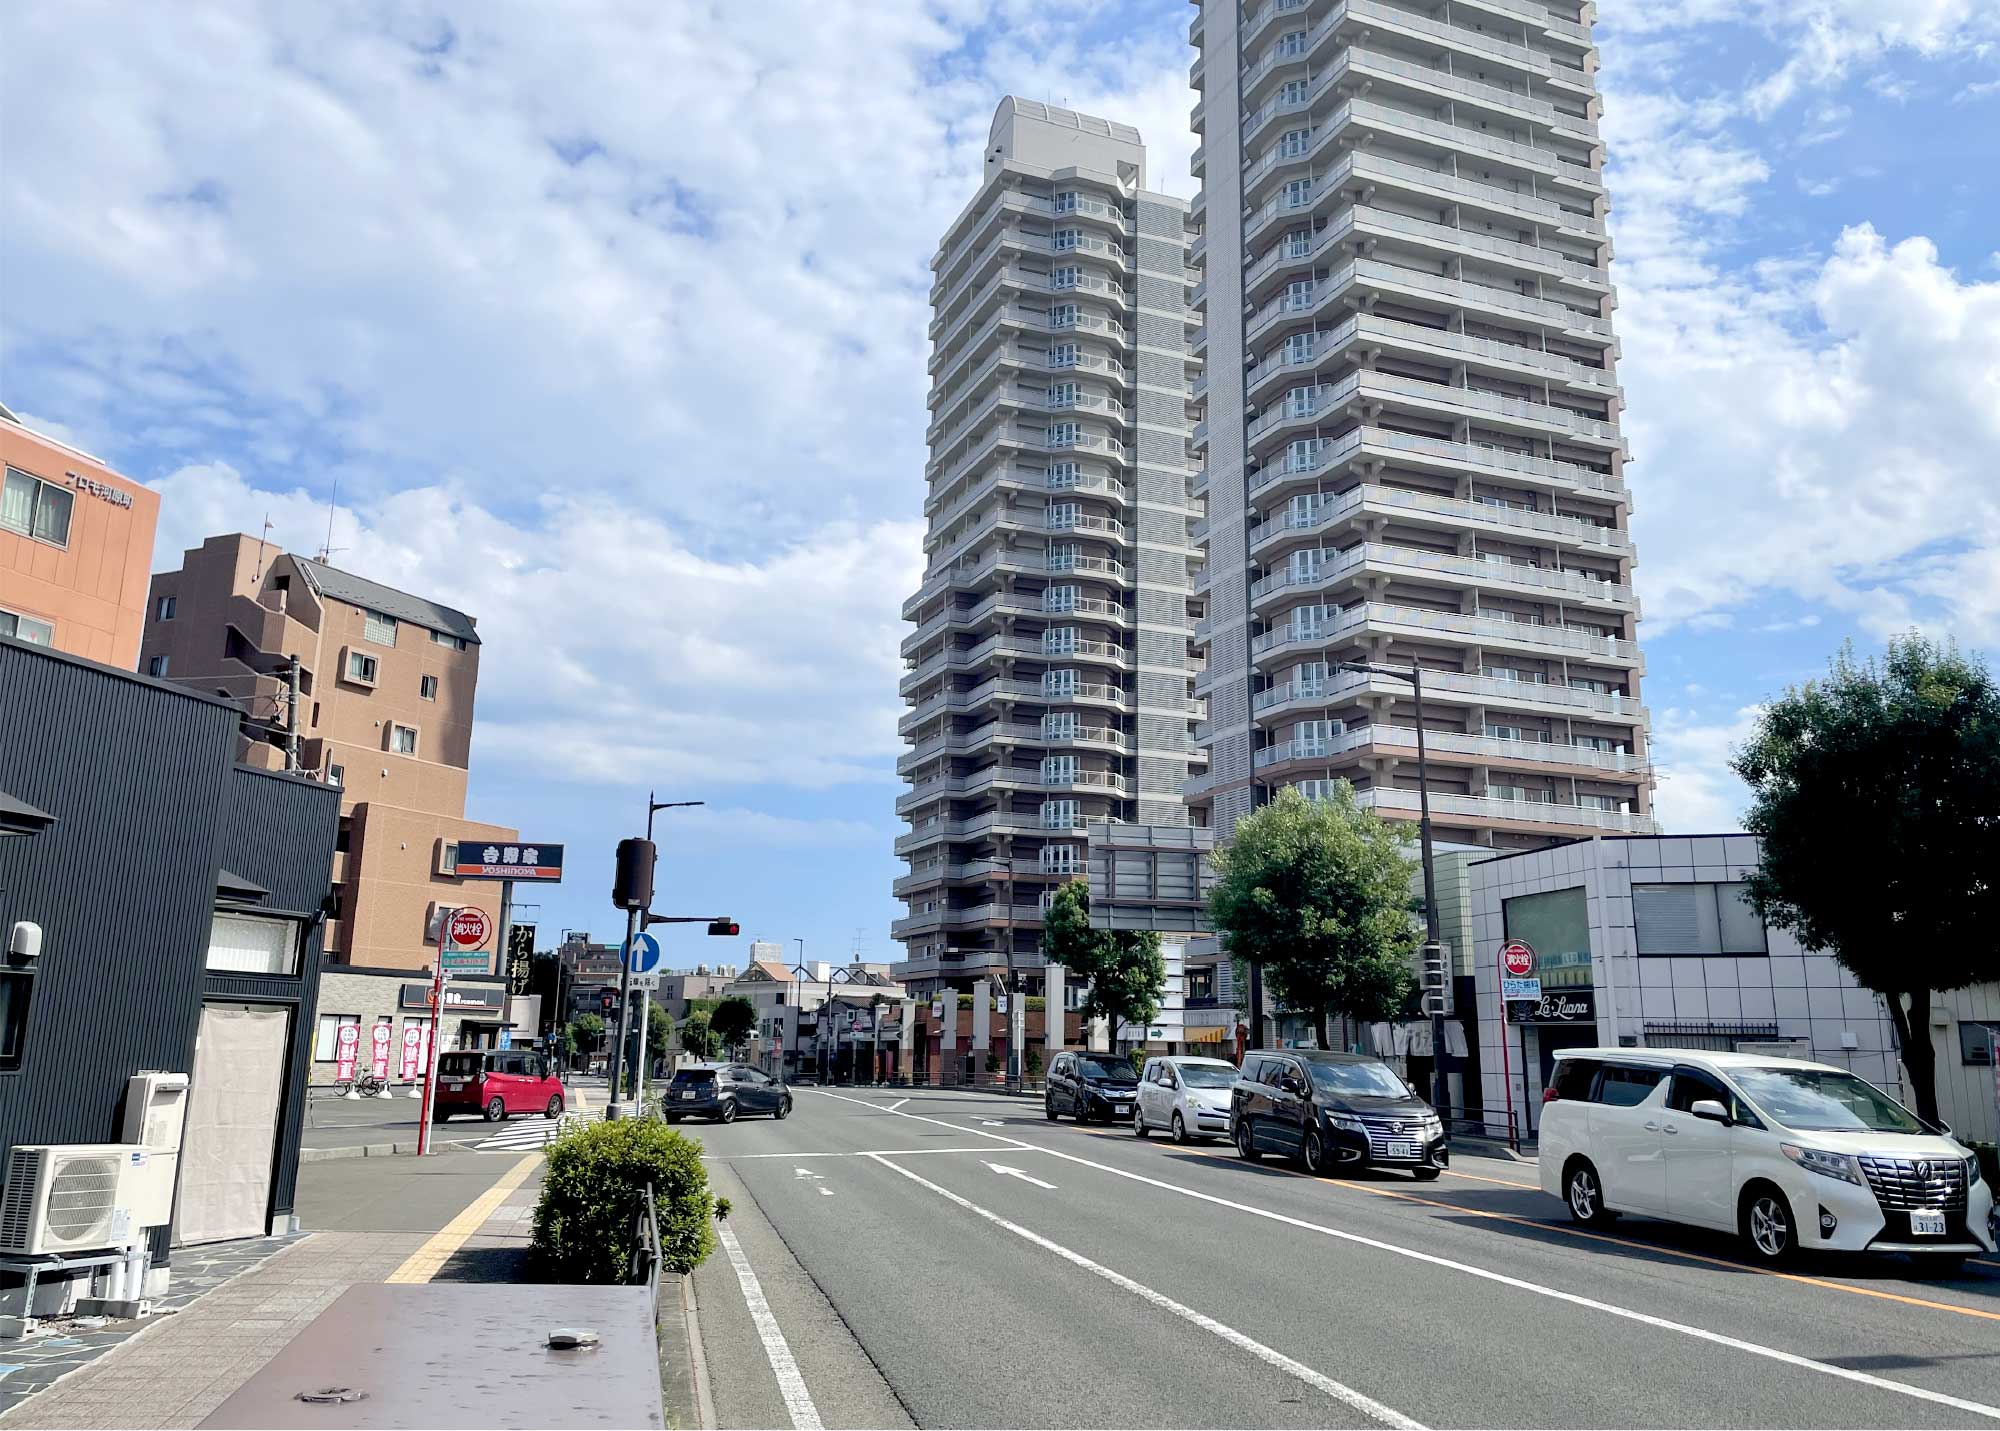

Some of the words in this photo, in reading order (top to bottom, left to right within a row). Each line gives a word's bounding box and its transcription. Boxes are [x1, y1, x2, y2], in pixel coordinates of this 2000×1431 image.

[453, 922, 483, 936] 消火栓
[511, 926, 533, 995] から揚げ
[1506, 953, 1530, 966] 消火栓
[629, 977, 656, 987] 車を除く
[1919, 1222, 1944, 1233] 31-23
